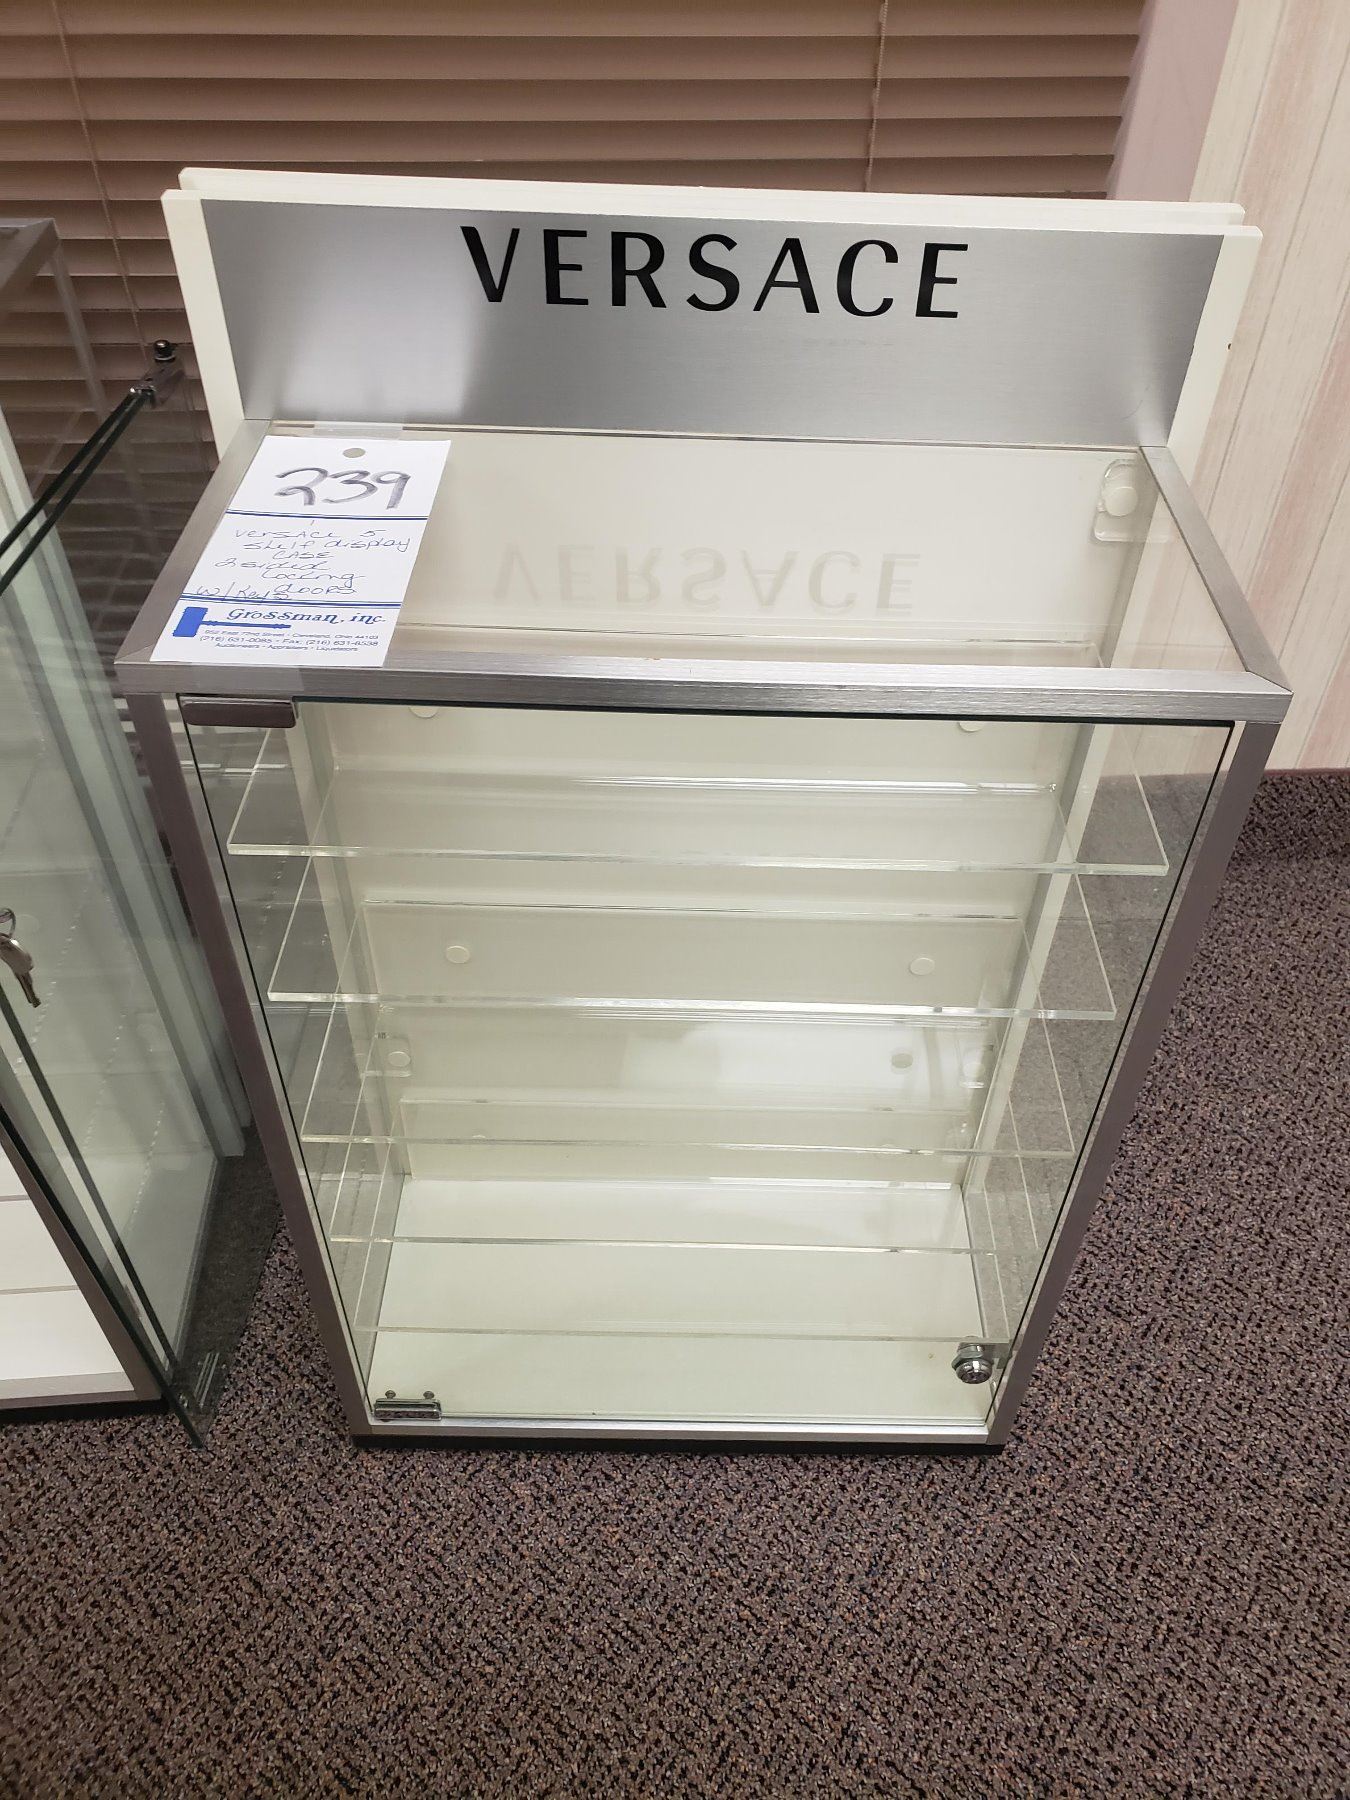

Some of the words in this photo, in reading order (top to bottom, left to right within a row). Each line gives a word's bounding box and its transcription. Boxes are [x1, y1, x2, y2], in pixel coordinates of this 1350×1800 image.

[460, 225, 969, 319] VERSACE
[274, 467, 411, 510] 239
[360, 529, 386, 538] 5
[324, 537, 410, 552] display
[226, 607, 344, 625] Grossman,
[350, 612, 387, 625] inc.
[199, 635, 225, 643] (216)
